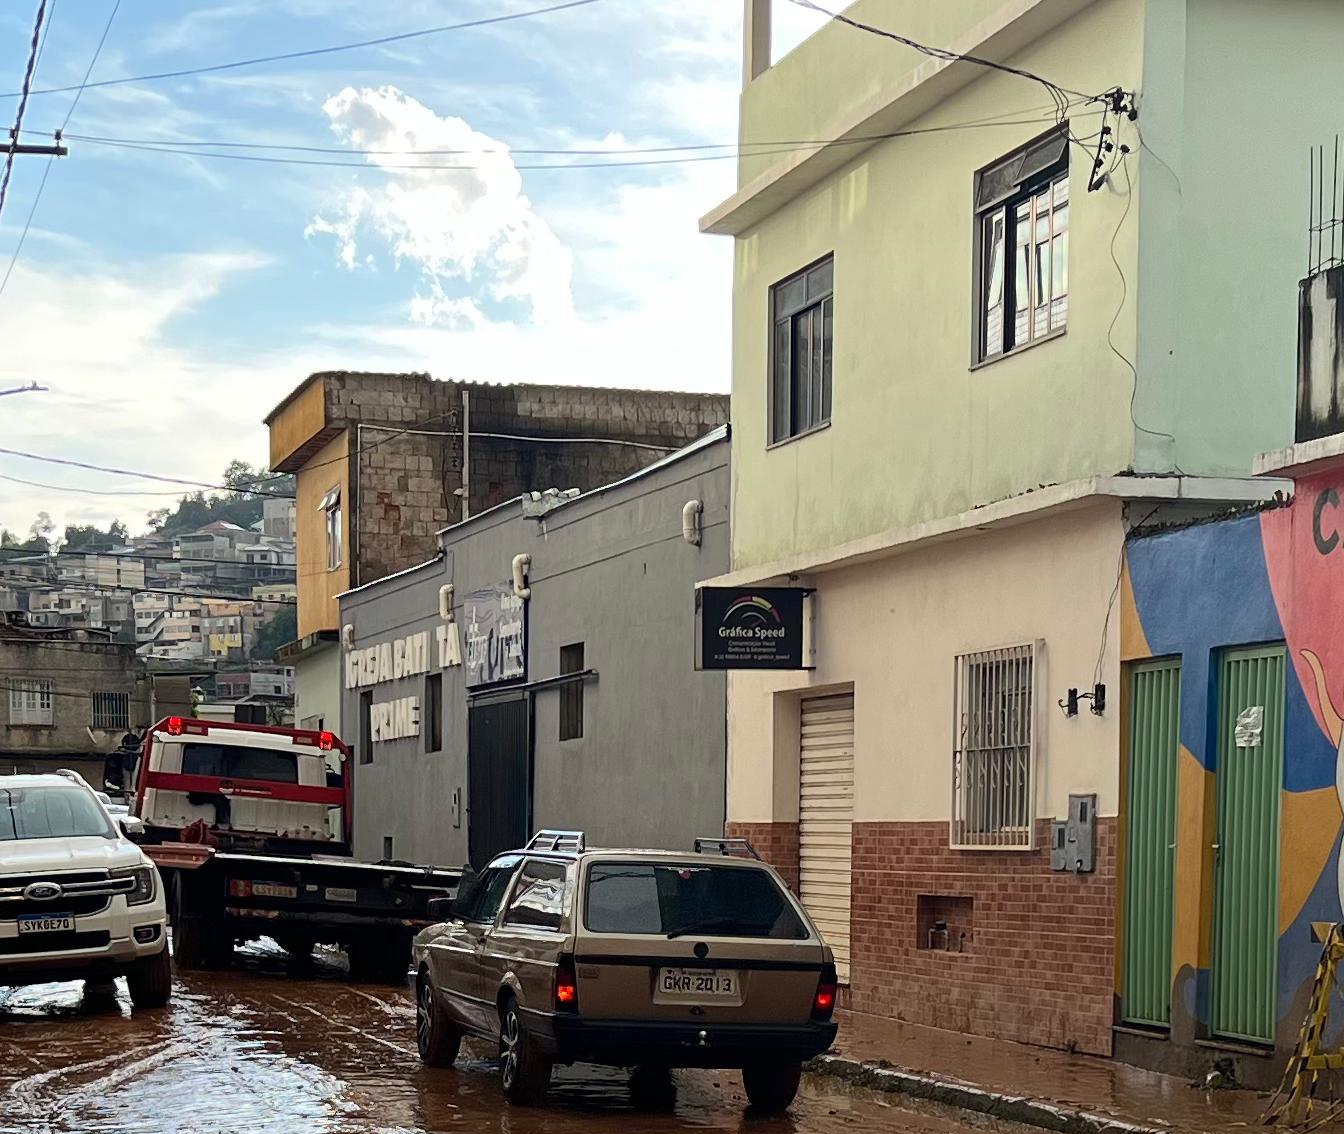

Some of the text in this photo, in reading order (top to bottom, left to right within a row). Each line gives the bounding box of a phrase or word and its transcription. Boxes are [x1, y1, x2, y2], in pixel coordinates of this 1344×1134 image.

[718, 626, 785, 640] Gráfica Speed
[370, 695, 420, 742] PRIME
